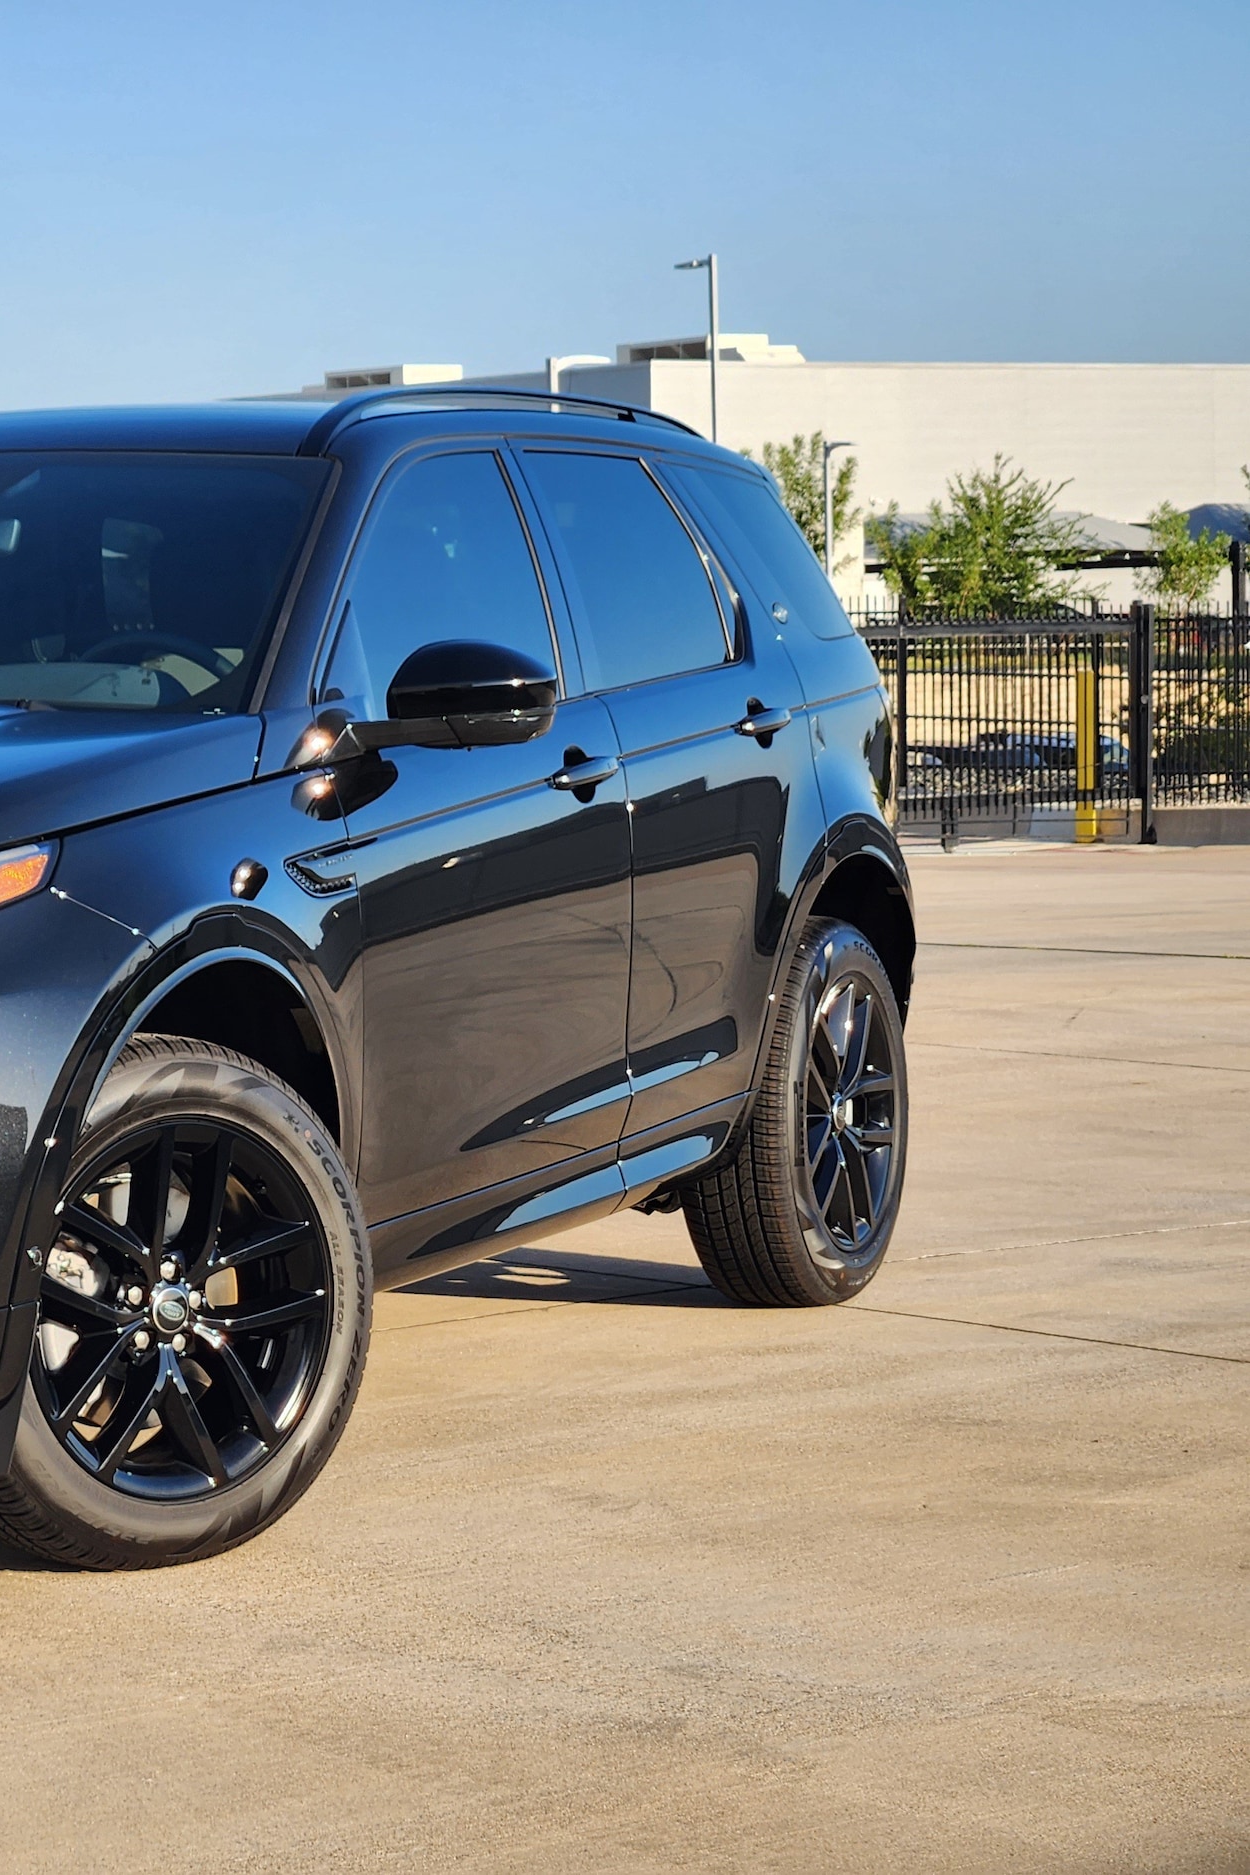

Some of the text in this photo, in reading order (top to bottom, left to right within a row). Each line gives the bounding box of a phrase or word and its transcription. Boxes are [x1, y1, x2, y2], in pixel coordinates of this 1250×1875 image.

[306, 1138, 366, 1432] SCORPION ZERO
[329, 1230, 345, 1335] ALL SEASON
